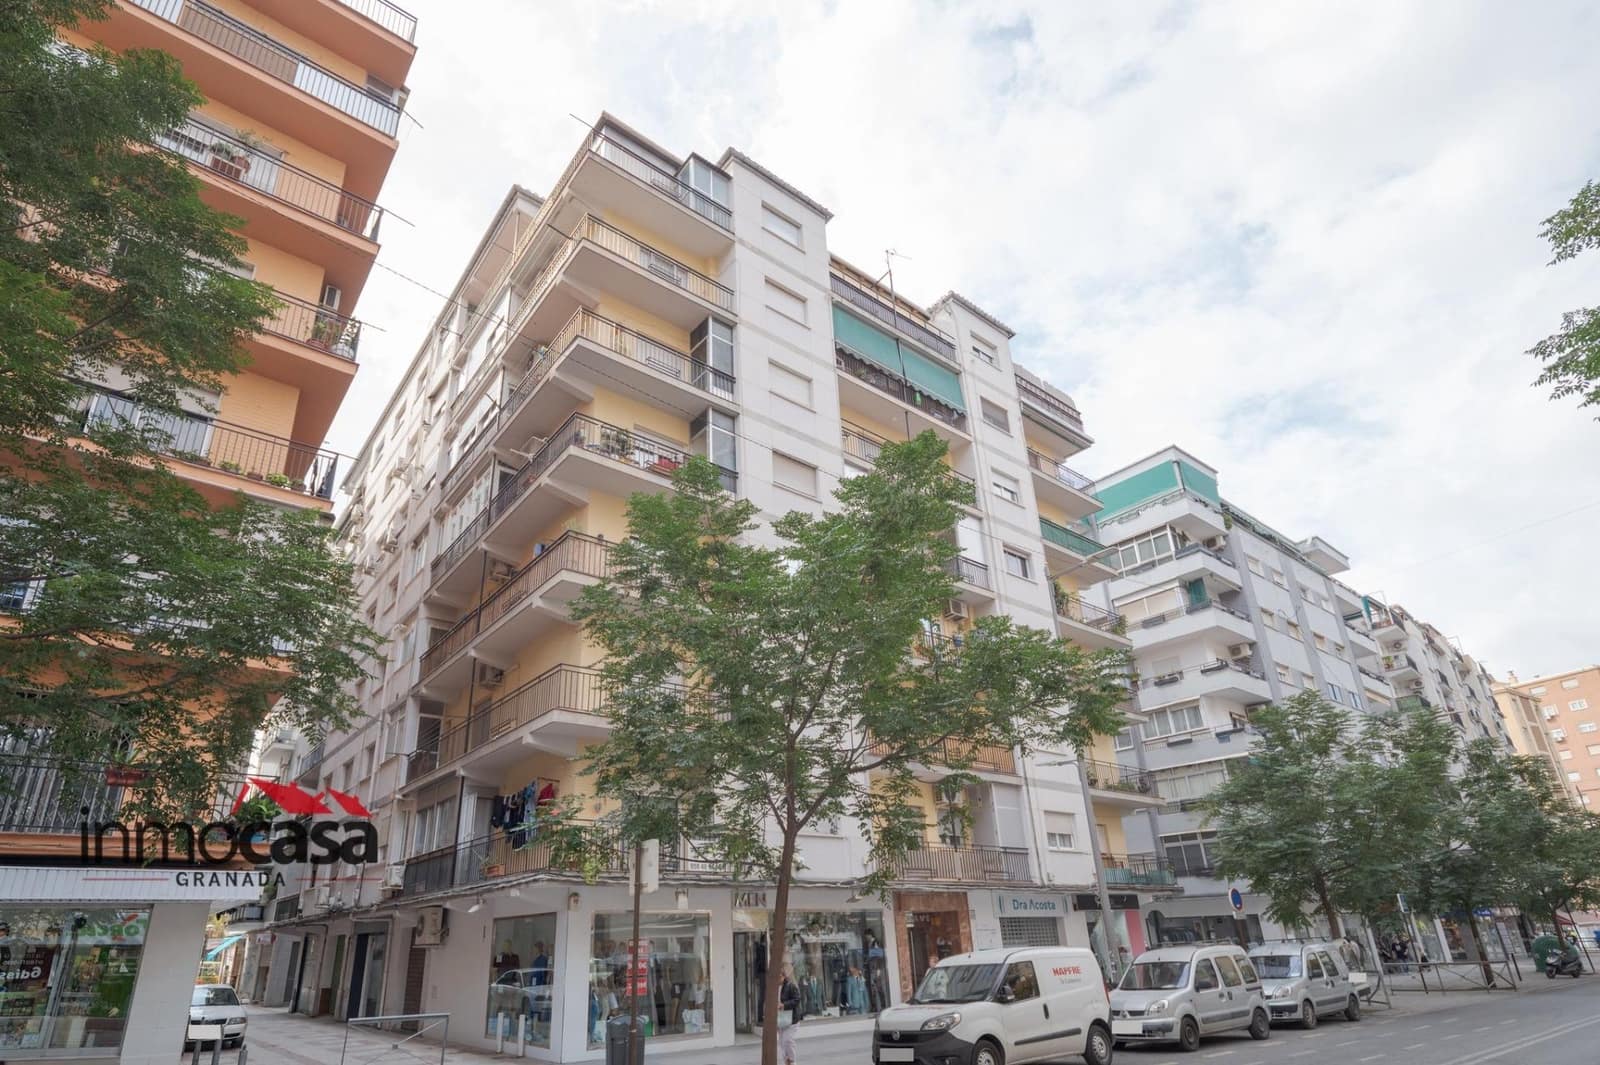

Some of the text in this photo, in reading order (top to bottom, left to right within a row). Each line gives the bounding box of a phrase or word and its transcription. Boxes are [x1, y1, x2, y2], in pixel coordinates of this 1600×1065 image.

[1012, 898, 1057, 911] Dra Acosta
[1051, 966, 1082, 977] MAPFRE
